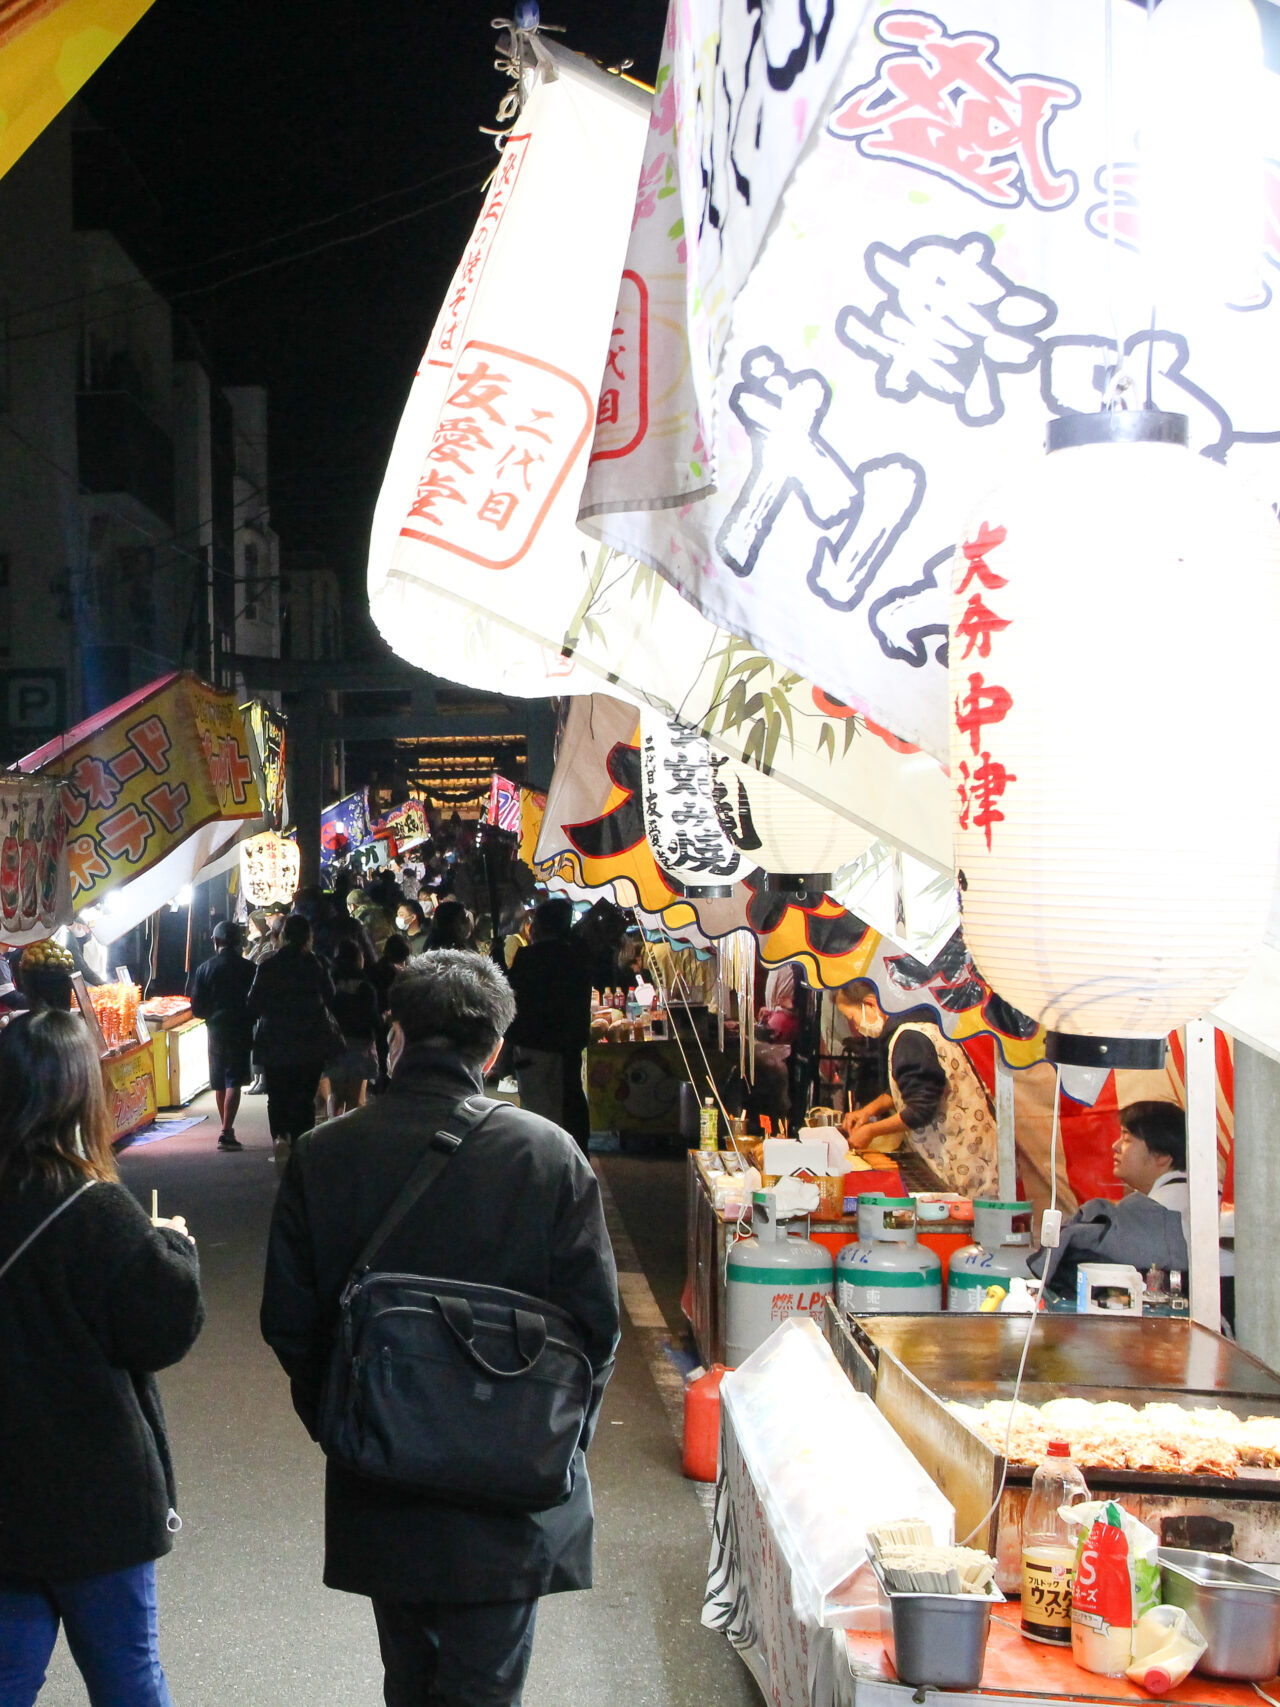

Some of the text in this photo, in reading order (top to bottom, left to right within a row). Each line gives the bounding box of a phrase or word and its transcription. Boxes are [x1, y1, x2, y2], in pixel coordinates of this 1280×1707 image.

[407, 361, 513, 527] 友愛堂
[476, 407, 555, 532] 二代目
[953, 520, 1018, 854] 大分中津
